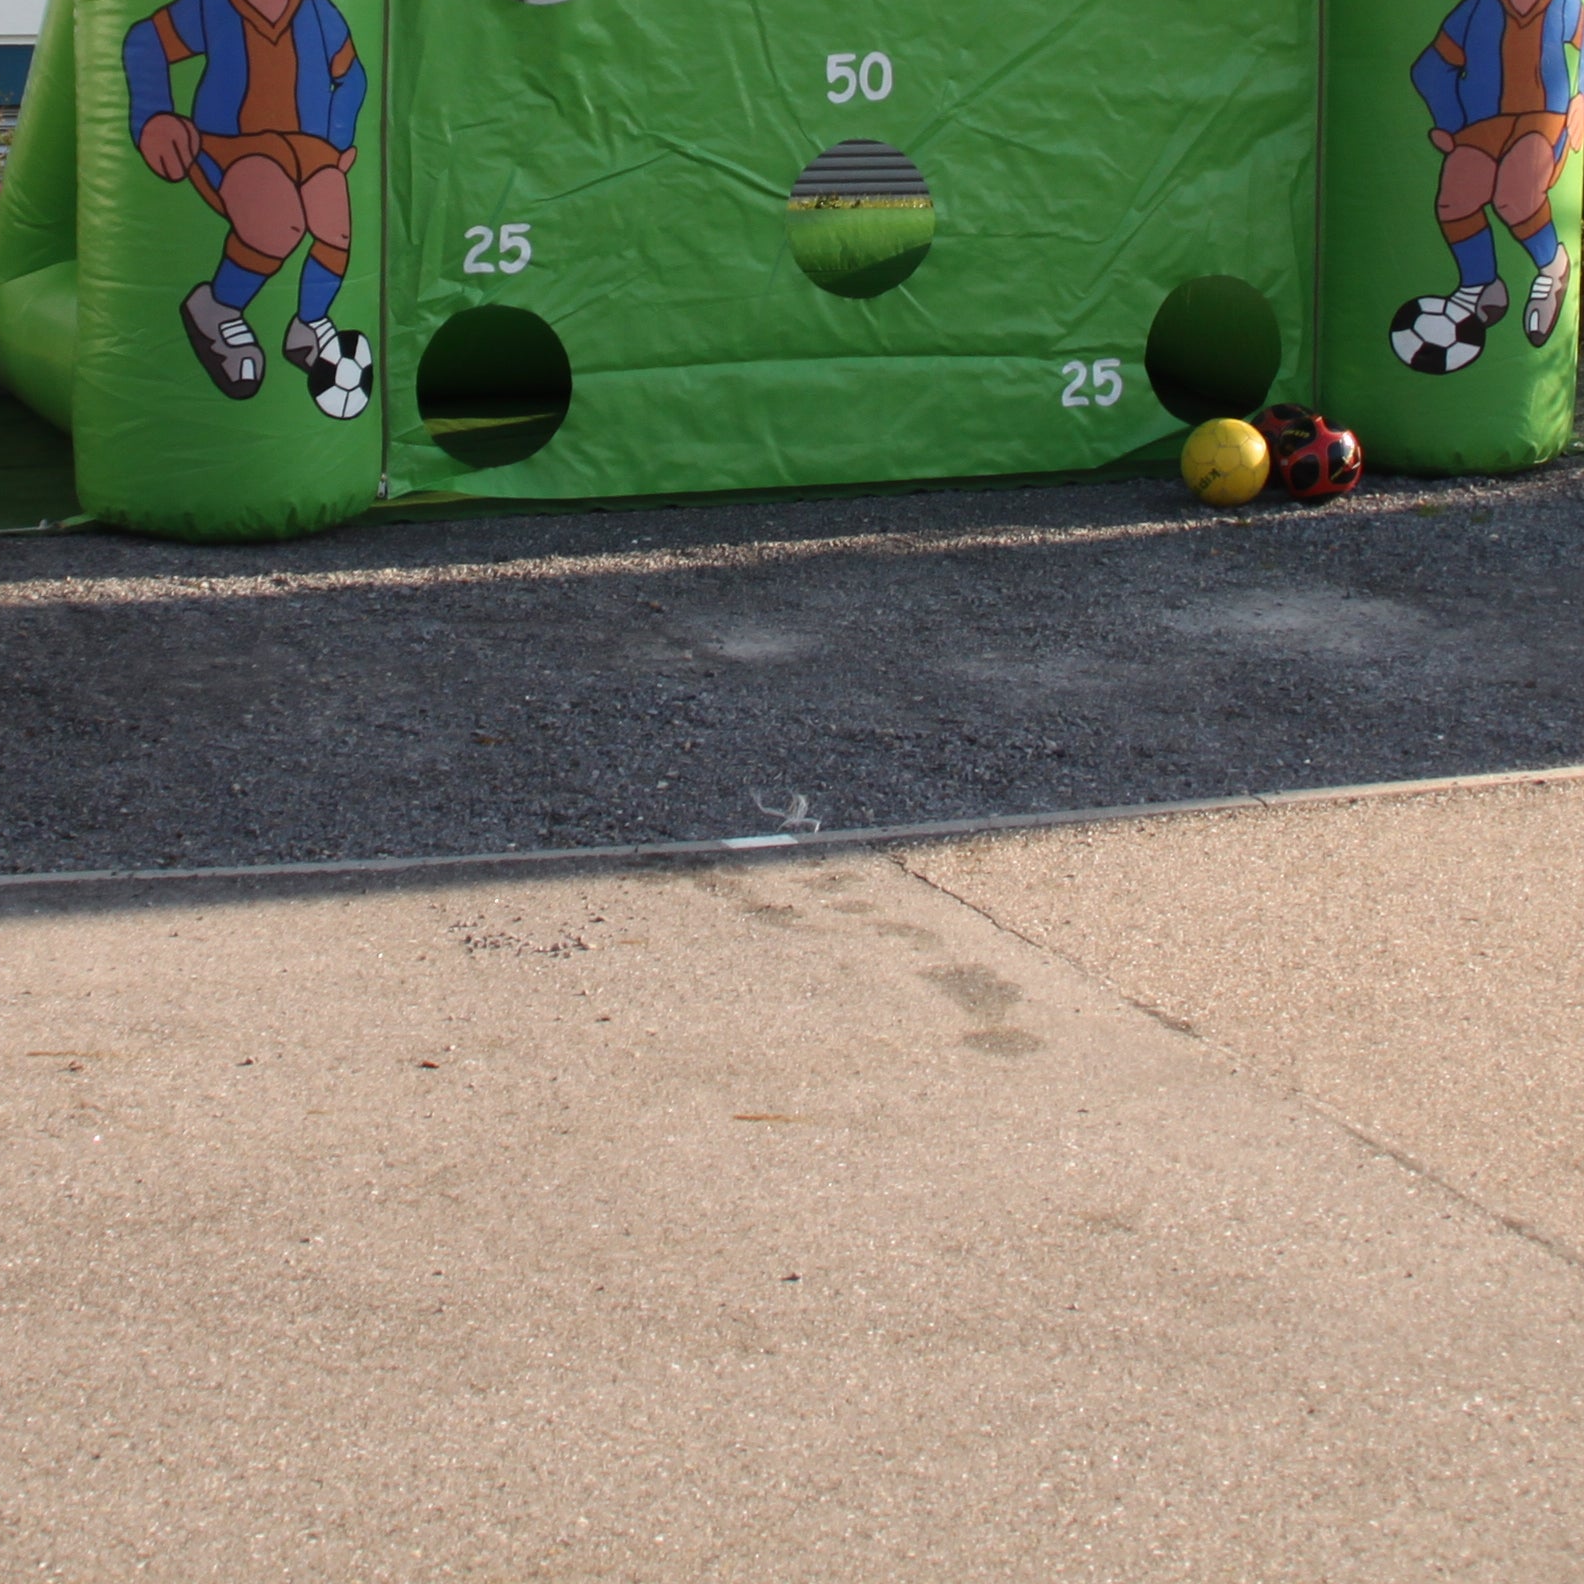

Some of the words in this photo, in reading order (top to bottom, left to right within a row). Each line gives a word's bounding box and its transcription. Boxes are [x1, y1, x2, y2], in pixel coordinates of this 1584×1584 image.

[826, 51, 893, 104] 50
[462, 223, 532, 274] 25
[1061, 358, 1124, 407] 25
